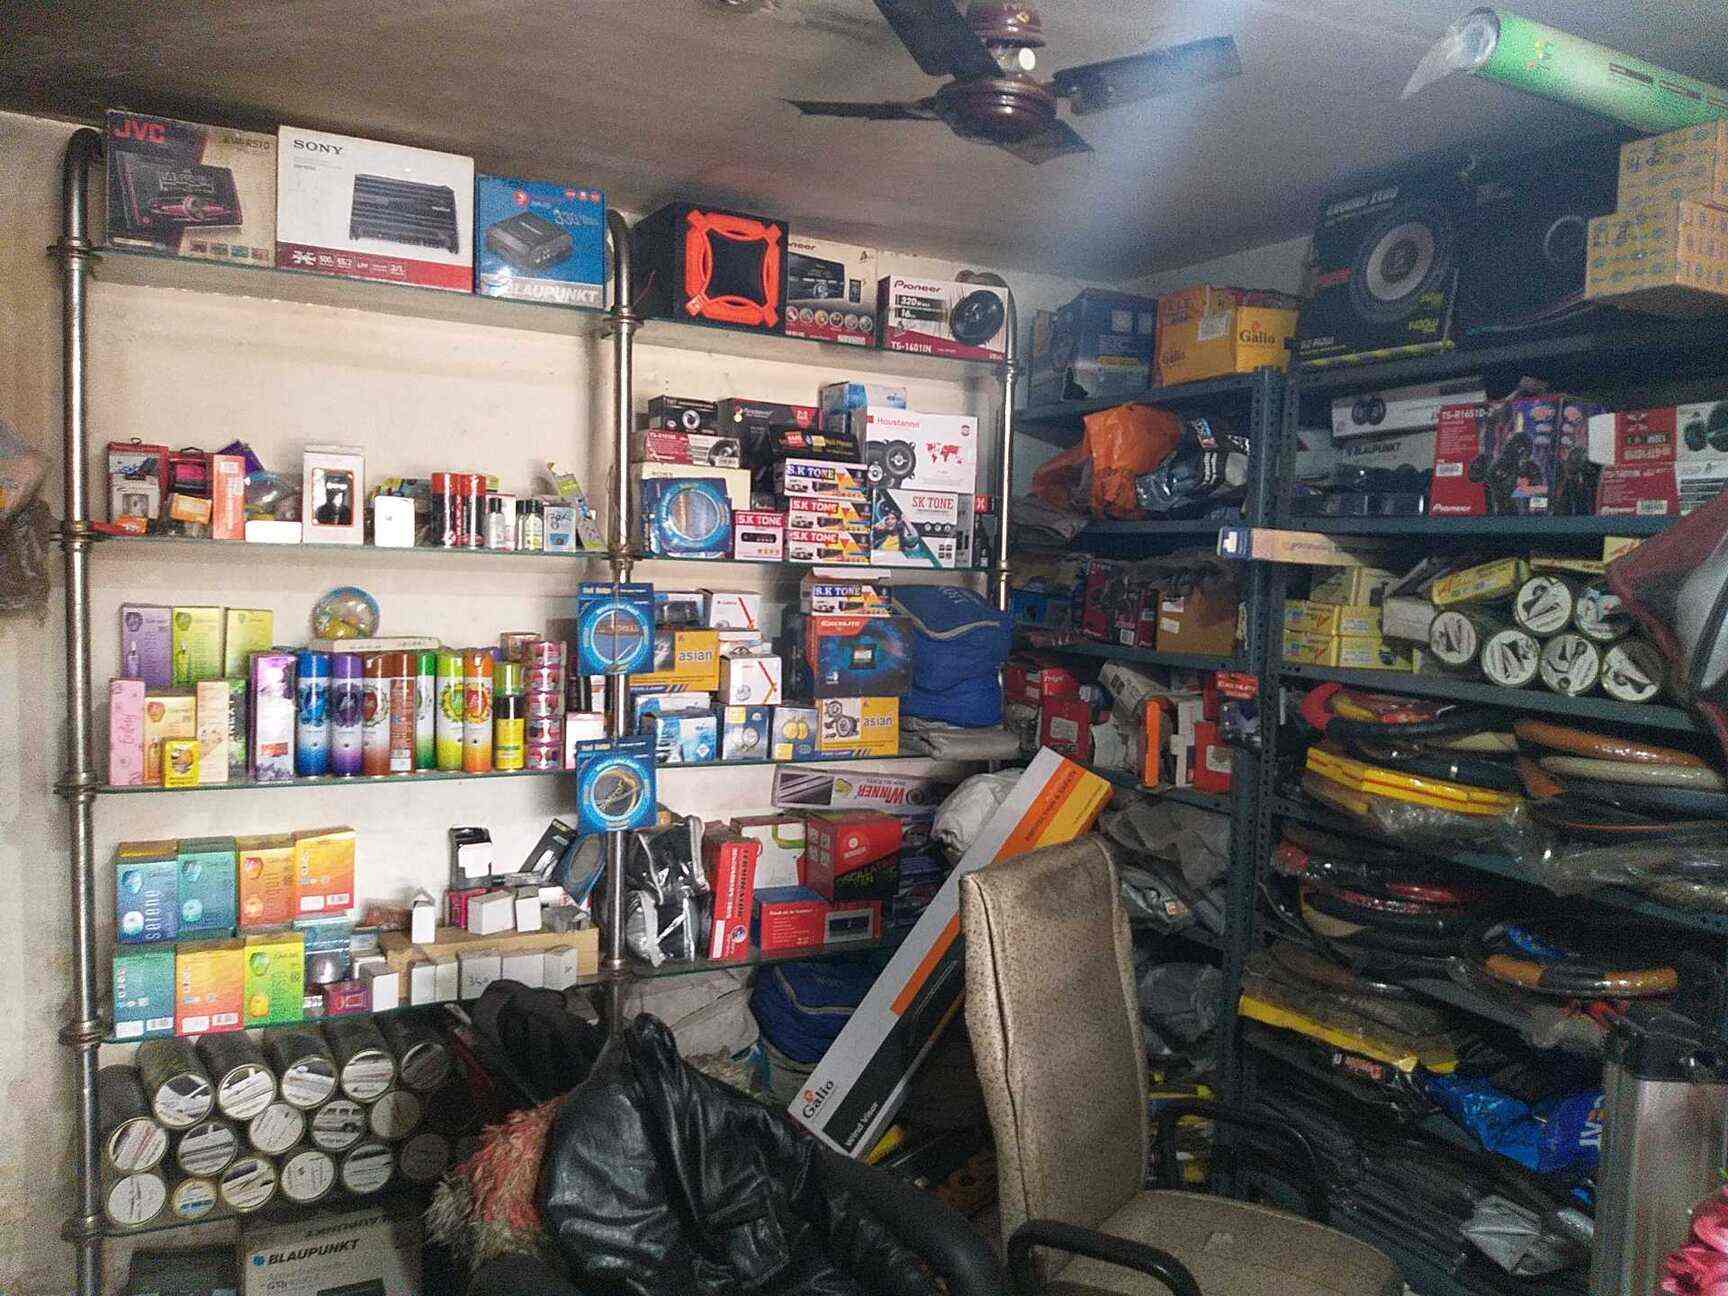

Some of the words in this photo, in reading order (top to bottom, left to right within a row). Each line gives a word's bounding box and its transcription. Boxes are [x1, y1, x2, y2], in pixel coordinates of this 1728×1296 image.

[112, 121, 166, 143] JVC
[293, 139, 343, 155] SONY
[895, 280, 941, 294] Pioneer
[927, 498, 954, 510] TONE
[678, 650, 713, 662] asian
[863, 715, 893, 727] asian
[802, 1080, 835, 1119] Galio
[268, 1238, 360, 1266] BLAUPUNKT
